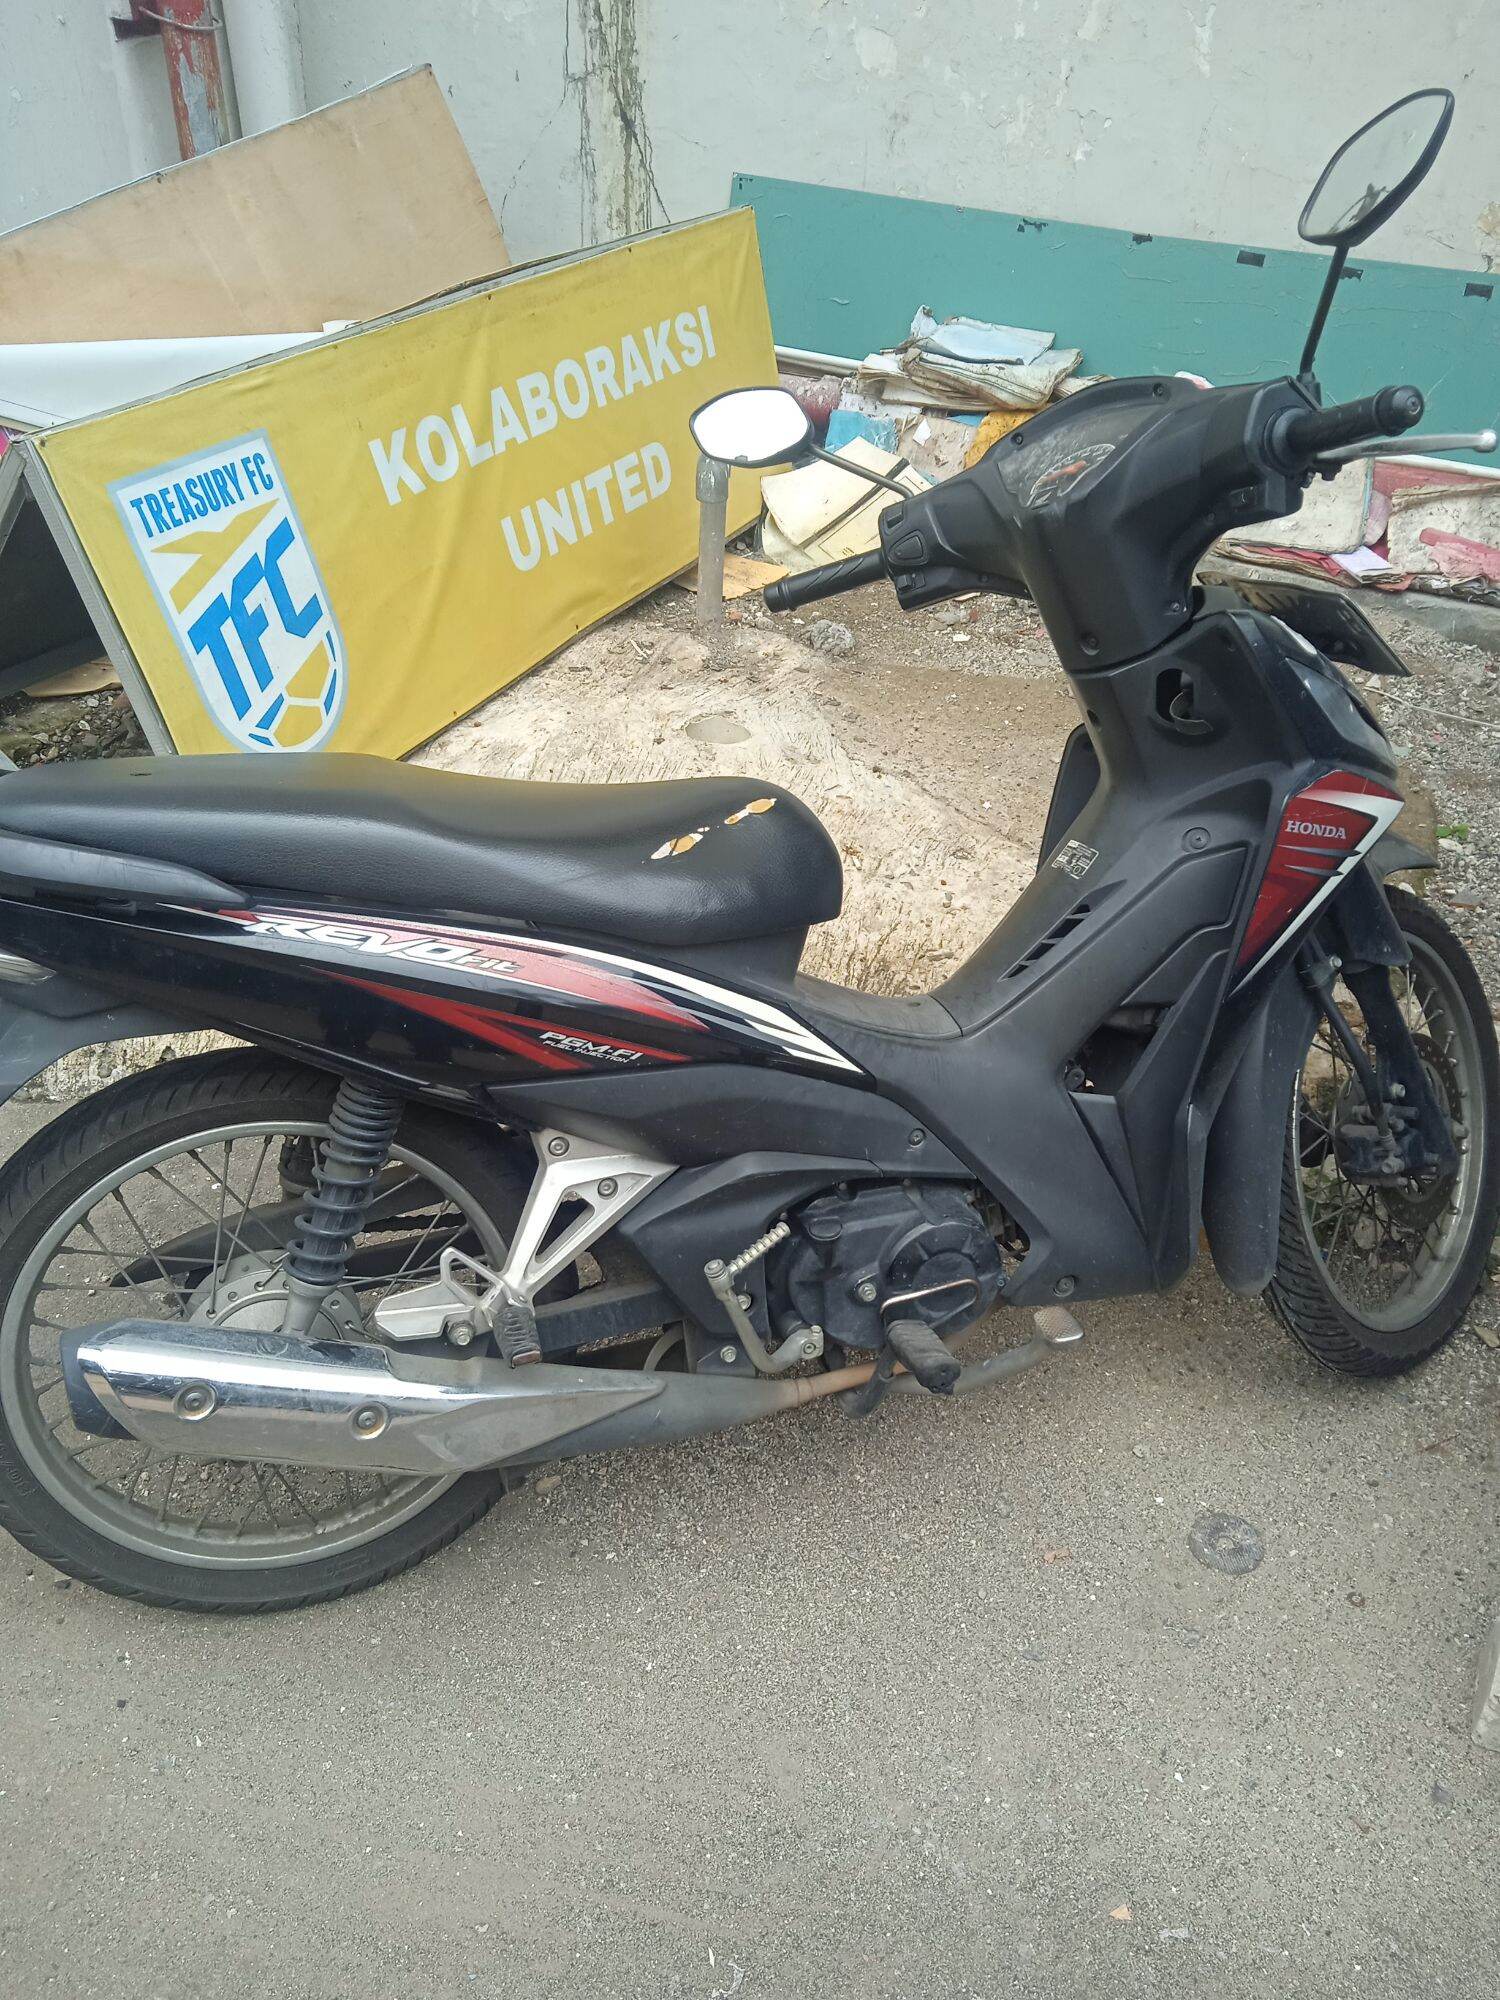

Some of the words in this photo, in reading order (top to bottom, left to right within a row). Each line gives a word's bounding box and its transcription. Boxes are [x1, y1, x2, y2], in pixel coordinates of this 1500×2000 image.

[367, 304, 717, 506] KOLABORAKSI
[129, 462, 245, 538] TREASURY
[240, 452, 274, 496] FC
[500, 441, 672, 572] UNITED
[187, 516, 324, 722] TFC
[1284, 820, 1347, 840] HONDA
[244, 919, 481, 962] REVO
[543, 1040, 573, 1052] FUEL
[573, 1048, 630, 1063] INJECTION
